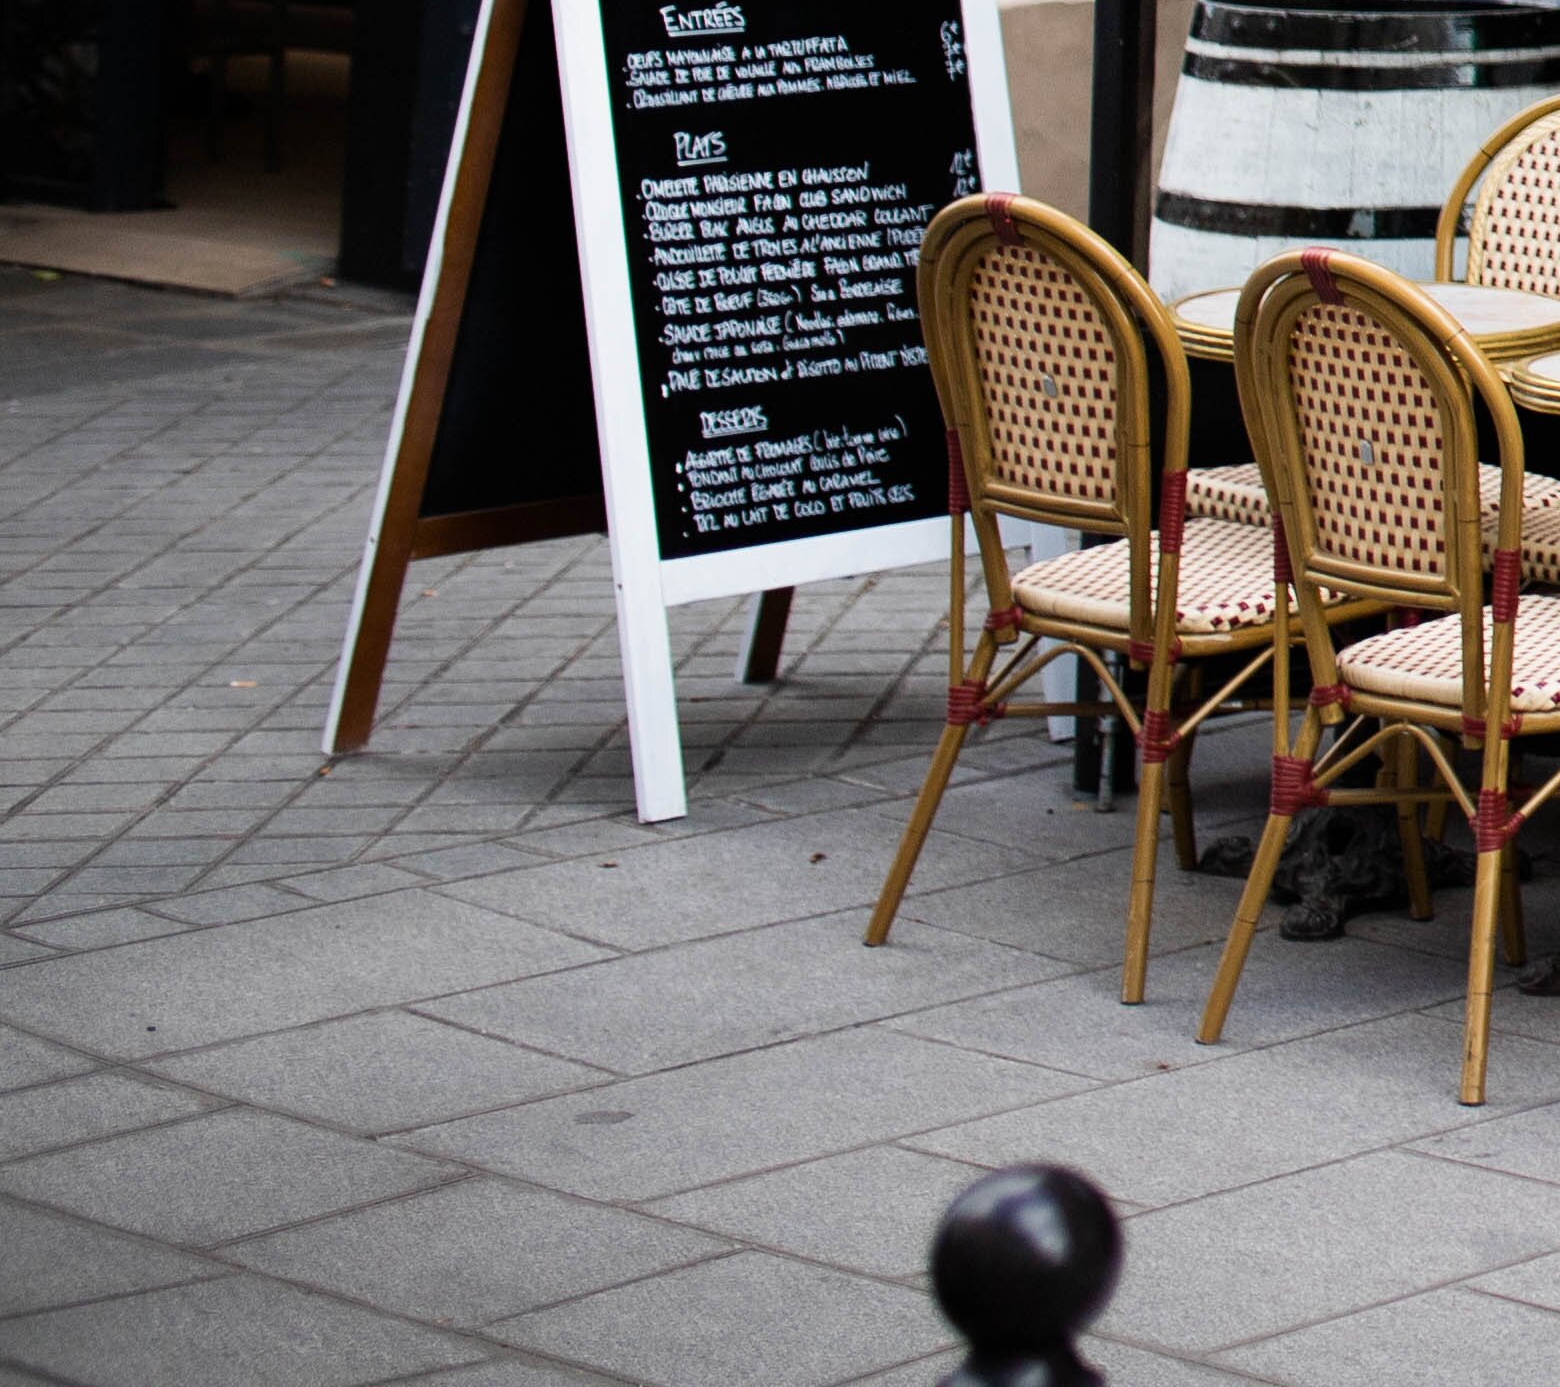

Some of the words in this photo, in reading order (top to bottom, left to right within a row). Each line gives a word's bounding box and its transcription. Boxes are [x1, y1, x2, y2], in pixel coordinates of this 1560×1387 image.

[673, 131, 728, 160] PLATS
[831, 182, 908, 205] SANDWICH
[801, 208, 869, 231] CHEDDAR
